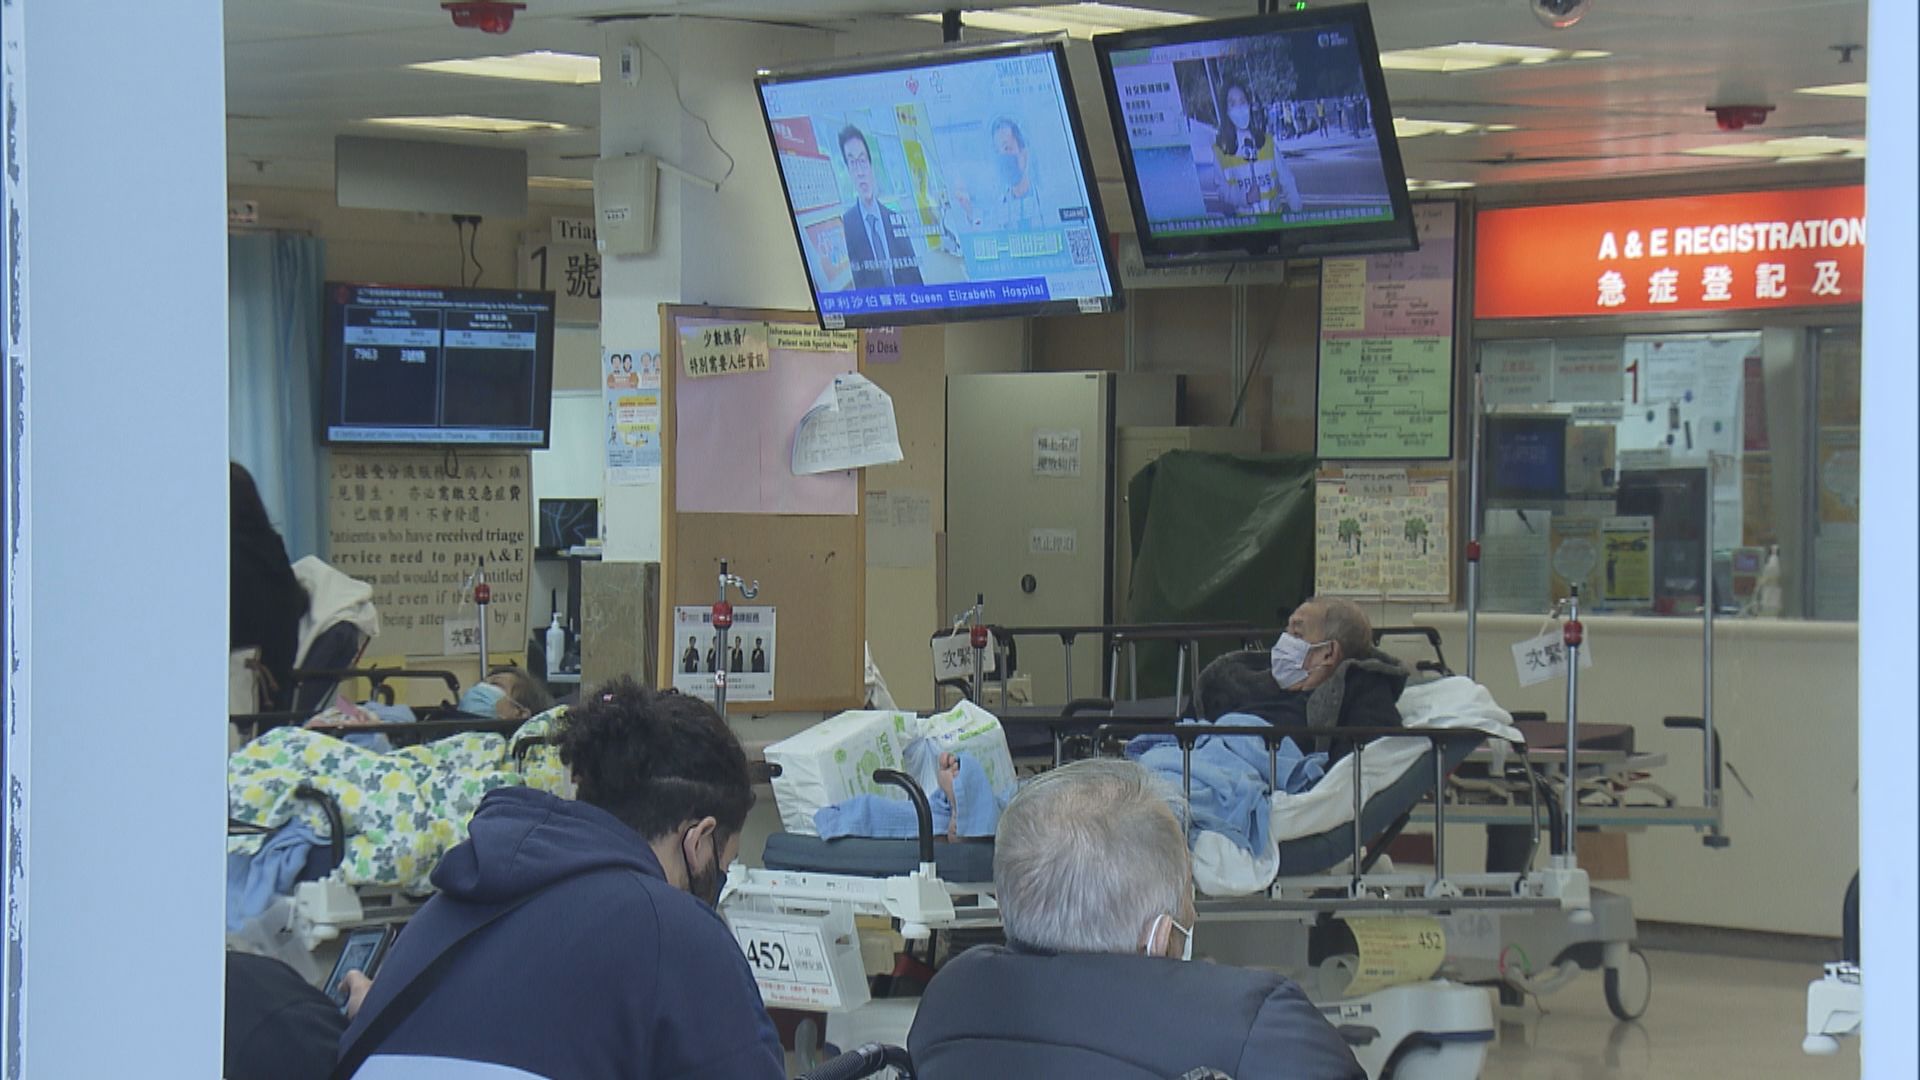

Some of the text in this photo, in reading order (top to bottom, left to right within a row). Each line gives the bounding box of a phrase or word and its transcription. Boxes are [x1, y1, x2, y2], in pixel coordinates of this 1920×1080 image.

[558, 219, 597, 241] Tria
[1598, 216, 1866, 260] A & E REGISTRATION
[823, 294, 908, 310] 伊利沙伯醫院
[910, 292, 943, 305] Queen
[948, 288, 996, 302] Elizabeth
[1001, 285, 1044, 299] Hospital
[877, 339, 899, 353] Desk
[1625, 358, 1640, 404] 1
[330, 527, 525, 545] atients who have received triage
[331, 549, 382, 564] ervice
[390, 549, 423, 564] need
[432, 550, 446, 564] to
[454, 552, 478, 568] pay
[380, 570, 401, 585] and
[403, 569, 439, 584] would
[441, 570, 459, 584] not
[482, 568, 524, 584] ntitled
[398, 592, 428, 605] even
[436, 590, 448, 605] if
[491, 591, 523, 604] eave
[382, 612, 414, 629] being
[494, 609, 507, 626] by
[513, 614, 521, 623] a
[942, 647, 986, 669] 次緊
[1525, 642, 1580, 671] 次緊
[1418, 932, 1442, 950] 452
[747, 939, 790, 972] 452
